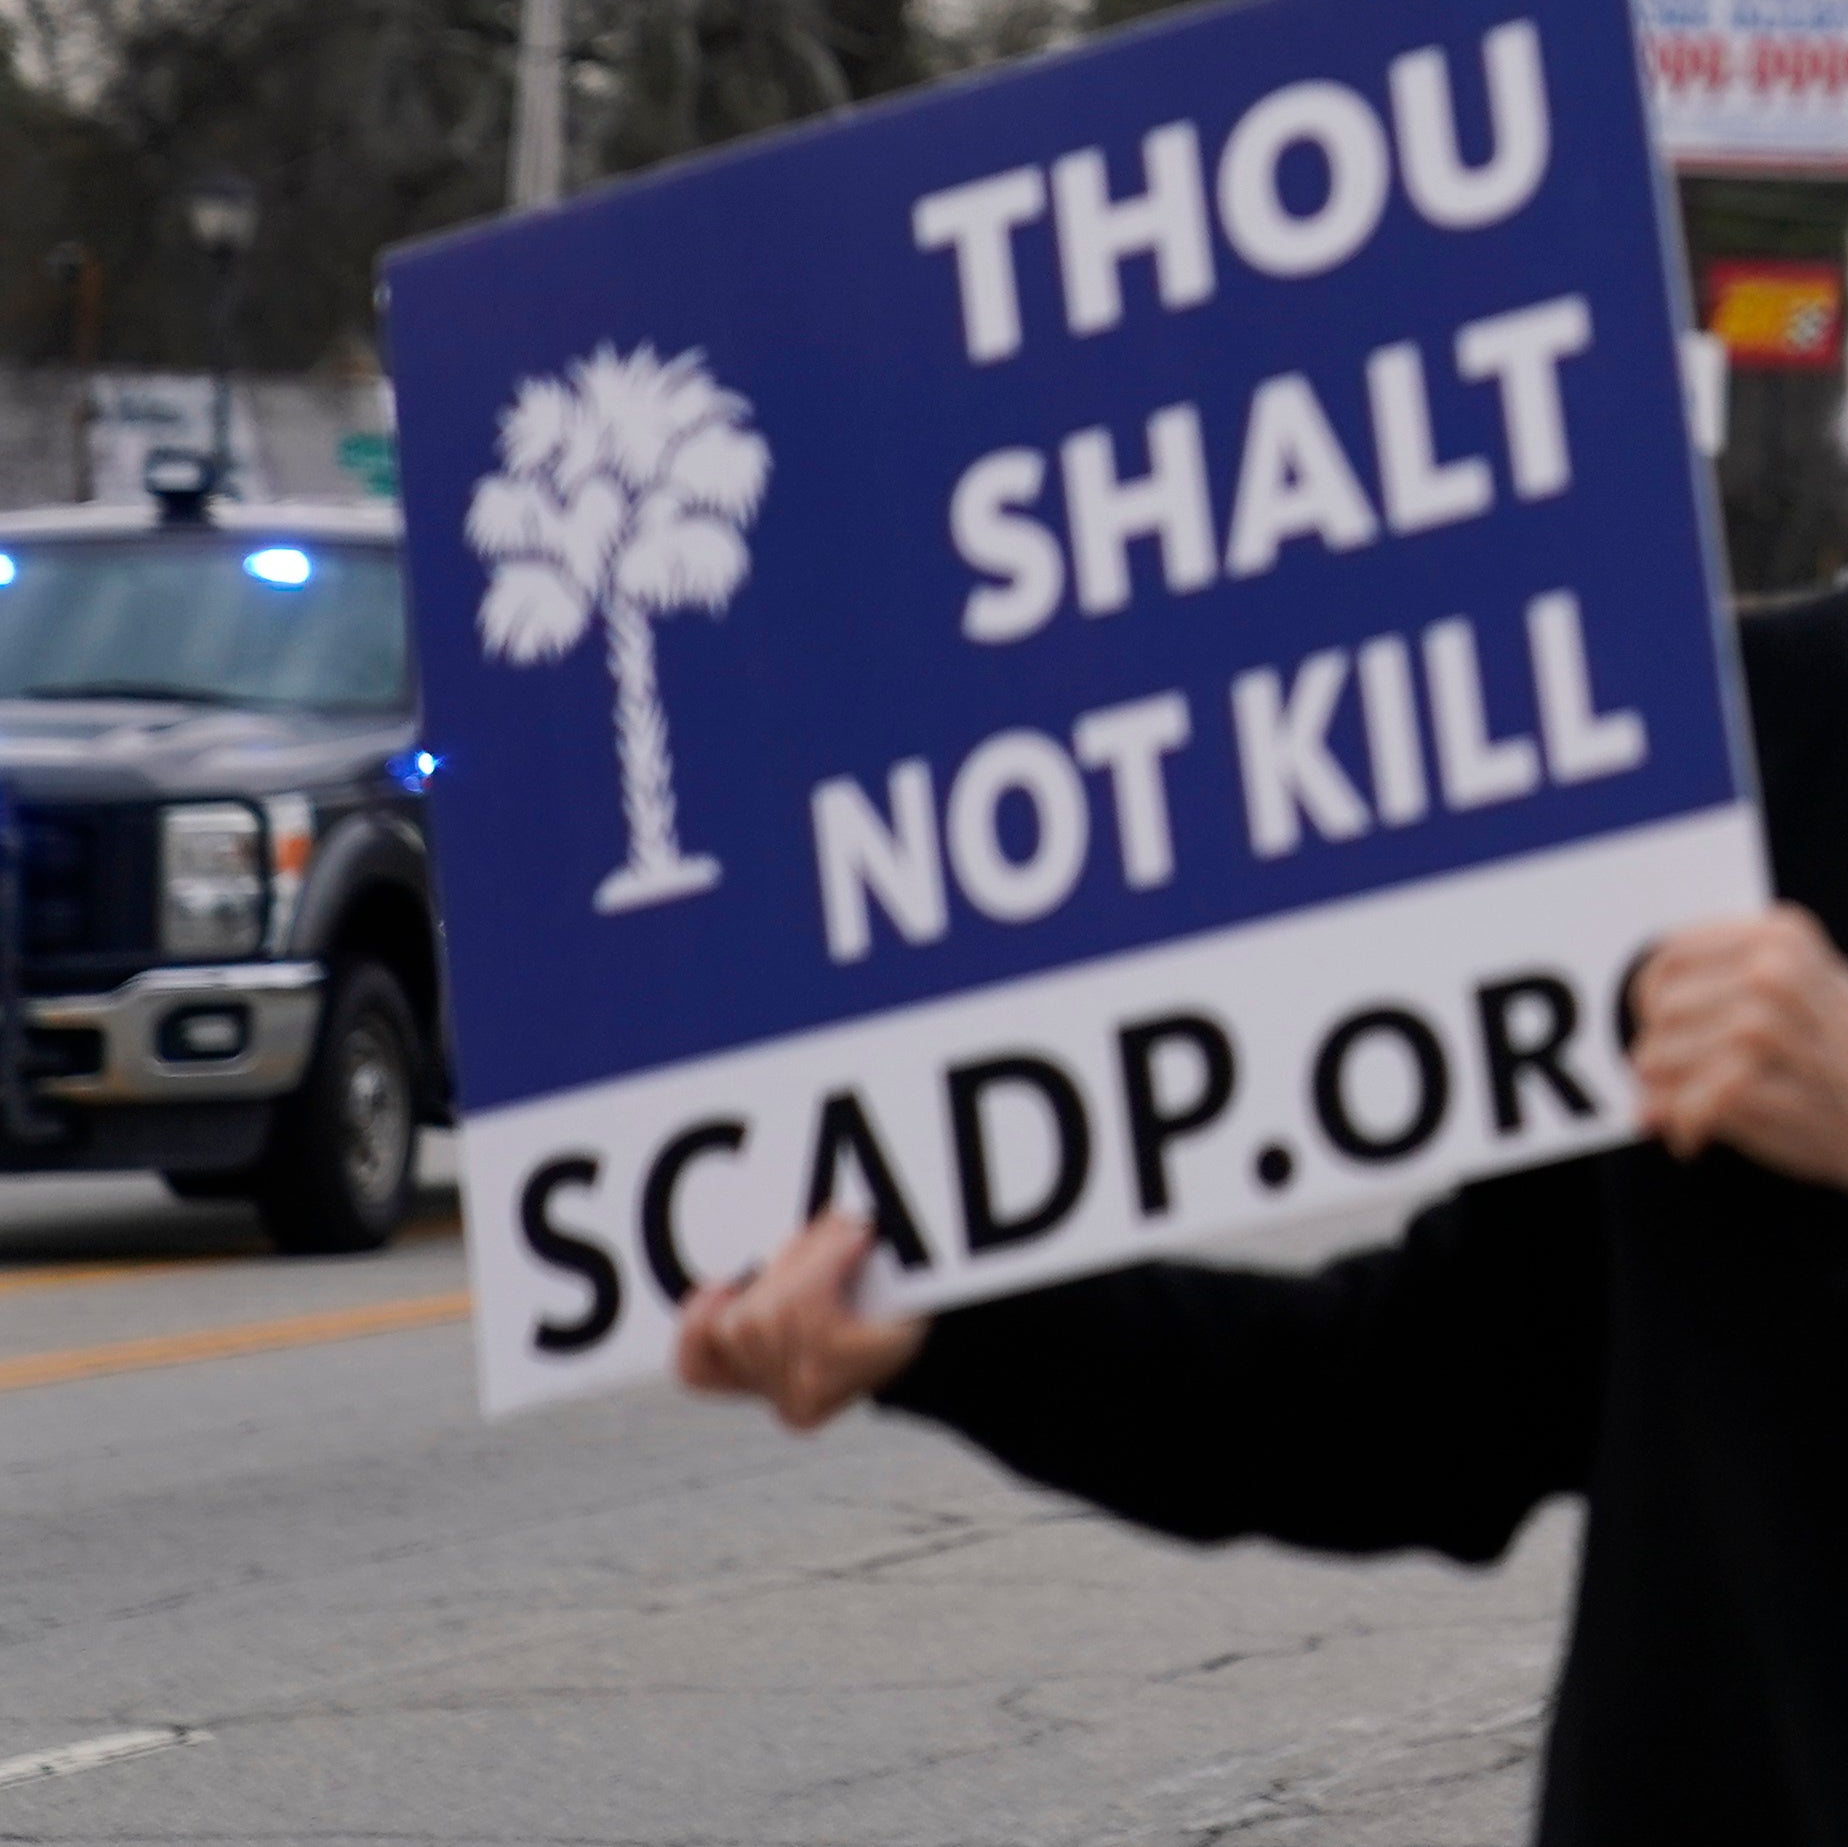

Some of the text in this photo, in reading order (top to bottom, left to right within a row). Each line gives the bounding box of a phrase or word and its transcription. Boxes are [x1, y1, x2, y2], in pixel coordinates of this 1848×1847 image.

[914, 20, 1549, 360] THOU
[950, 299, 1590, 641] SHALT
[811, 593, 1644, 959] NOT KILL
[517, 950, 1655, 1354] SCADP.OR
